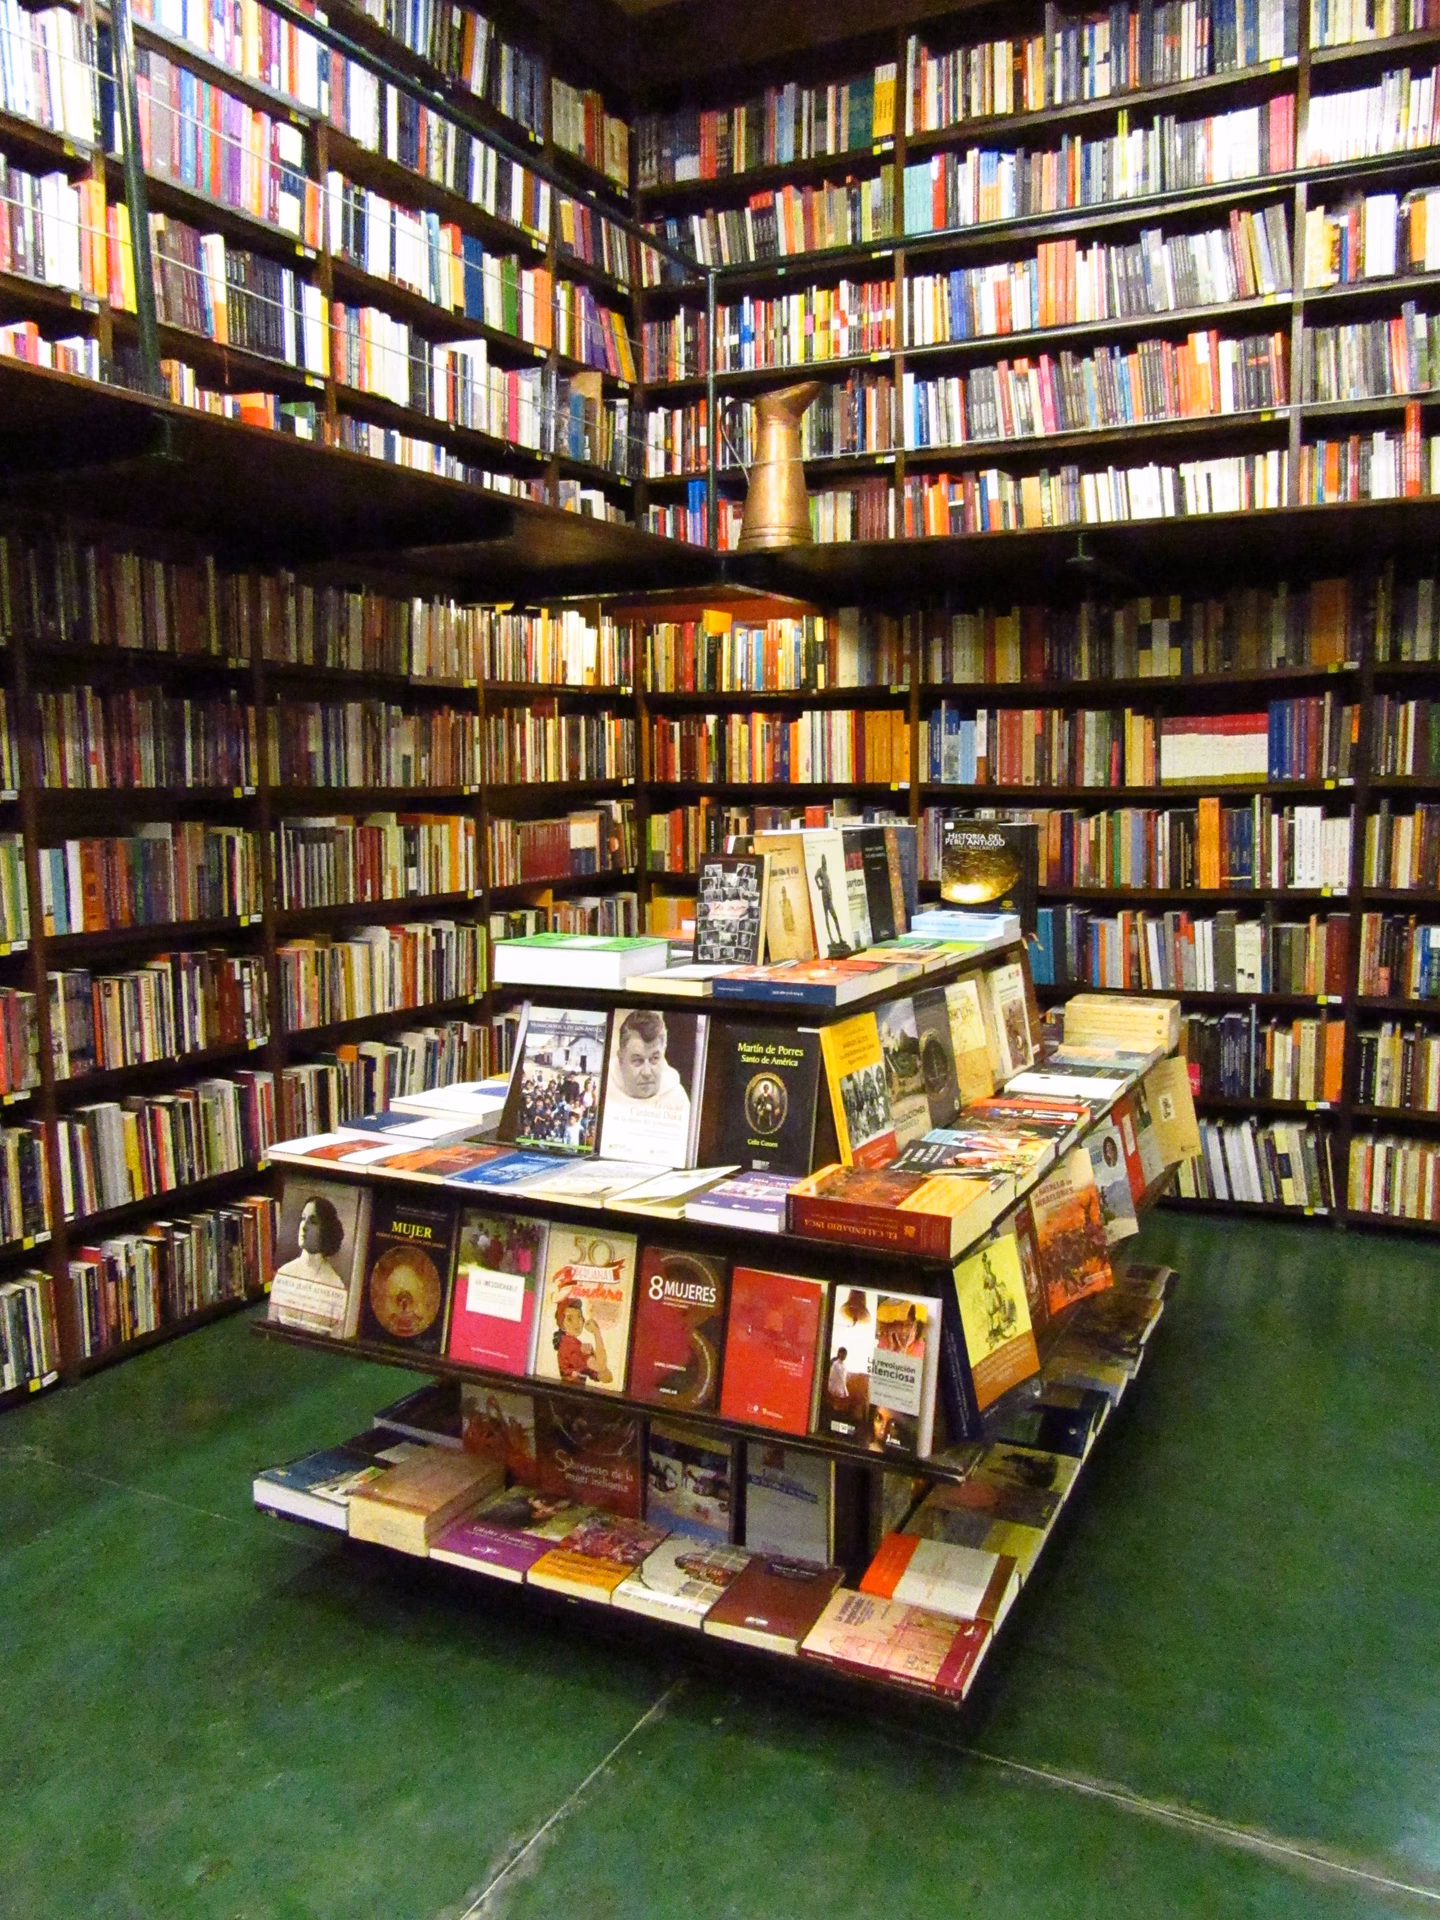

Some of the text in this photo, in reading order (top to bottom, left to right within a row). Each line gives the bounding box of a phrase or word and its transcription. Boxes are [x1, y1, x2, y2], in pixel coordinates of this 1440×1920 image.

[947, 832, 986, 840] HISTORIA
[966, 838, 1006, 847] ANTIGUO
[737, 1042, 804, 1057] Martín de Porres
[741, 1054, 799, 1067] Santo de América
[391, 1220, 433, 1240] MUJER
[804, 1218, 826, 1229] INCA
[827, 1223, 884, 1239] CALENDARIO
[568, 1233, 616, 1267] 50
[648, 1274, 664, 1300] 8
[664, 1279, 717, 1304] MUJERES
[867, 1364, 915, 1384] silenciosa
[877, 1359, 916, 1374] revolución
